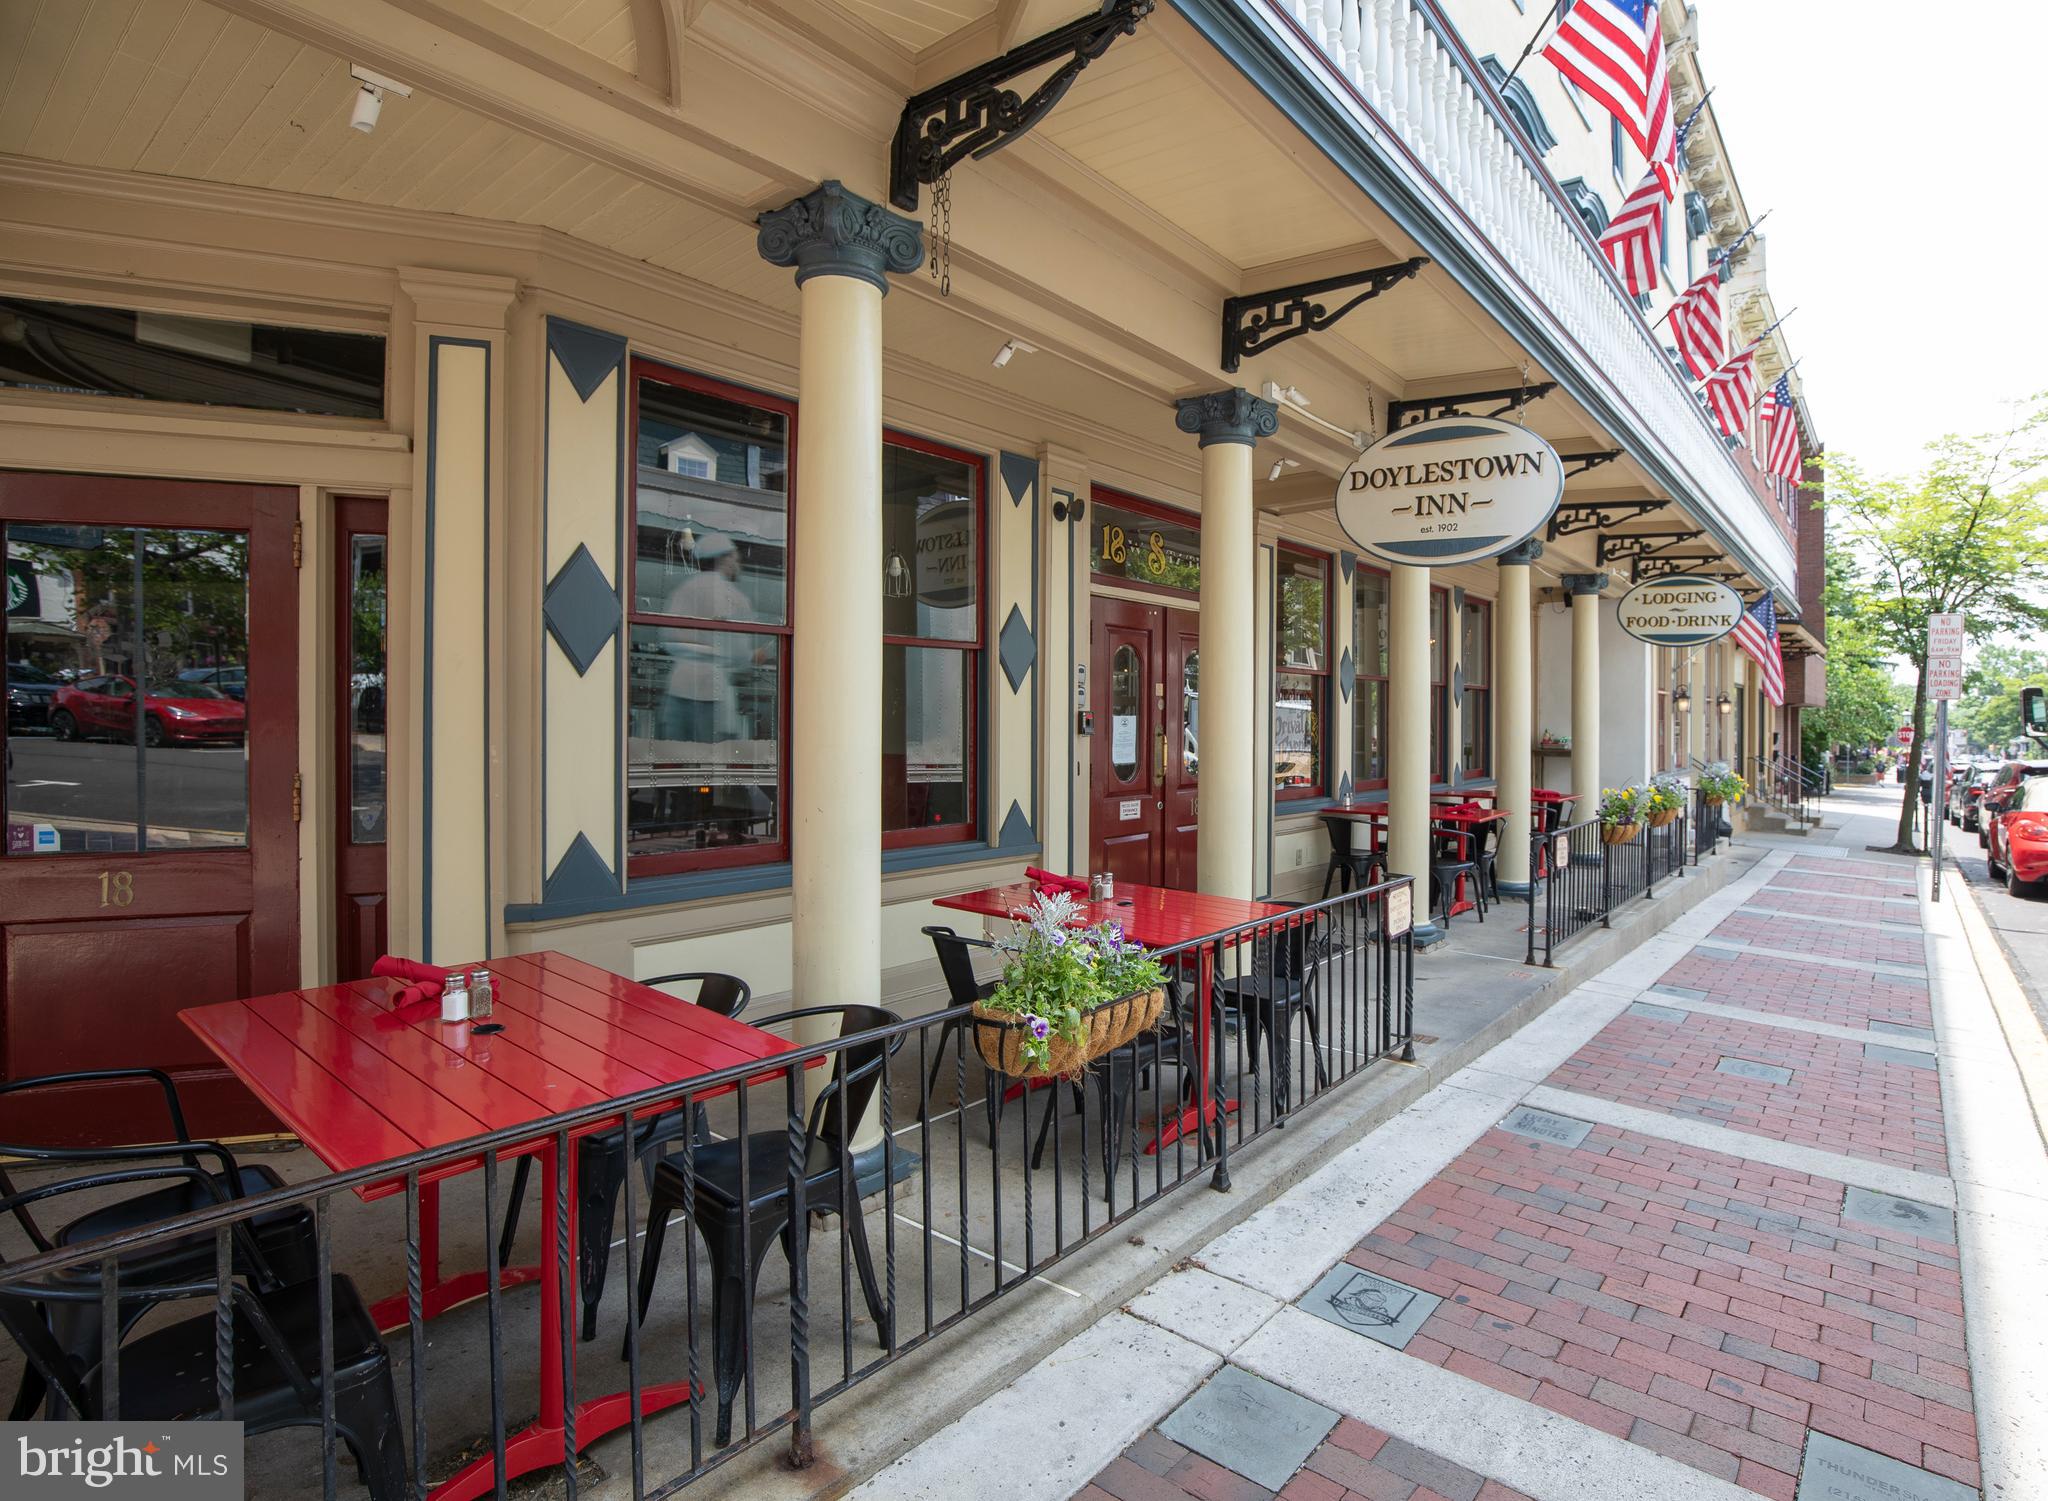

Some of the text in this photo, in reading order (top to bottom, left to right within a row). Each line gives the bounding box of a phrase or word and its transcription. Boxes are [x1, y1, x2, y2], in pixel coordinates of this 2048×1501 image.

[1349, 451, 1545, 491] DOYLESTOWN
[1414, 492, 1470, 517] INN
[1420, 523, 1459, 534] est. 1902
[1102, 523, 1127, 566] 18
[1642, 591, 1717, 605] LODGING
[1940, 617, 1951, 626] NO
[1931, 627, 1960, 636] PARKING
[1939, 660, 1951, 668] NO
[1929, 670, 1960, 678] PARKING
[1930, 680, 1959, 688] LOADING
[1936, 689, 1952, 697] ZONE
[98, 871, 134, 908] 18
[1514, 1121, 1569, 1140] MINUTES
